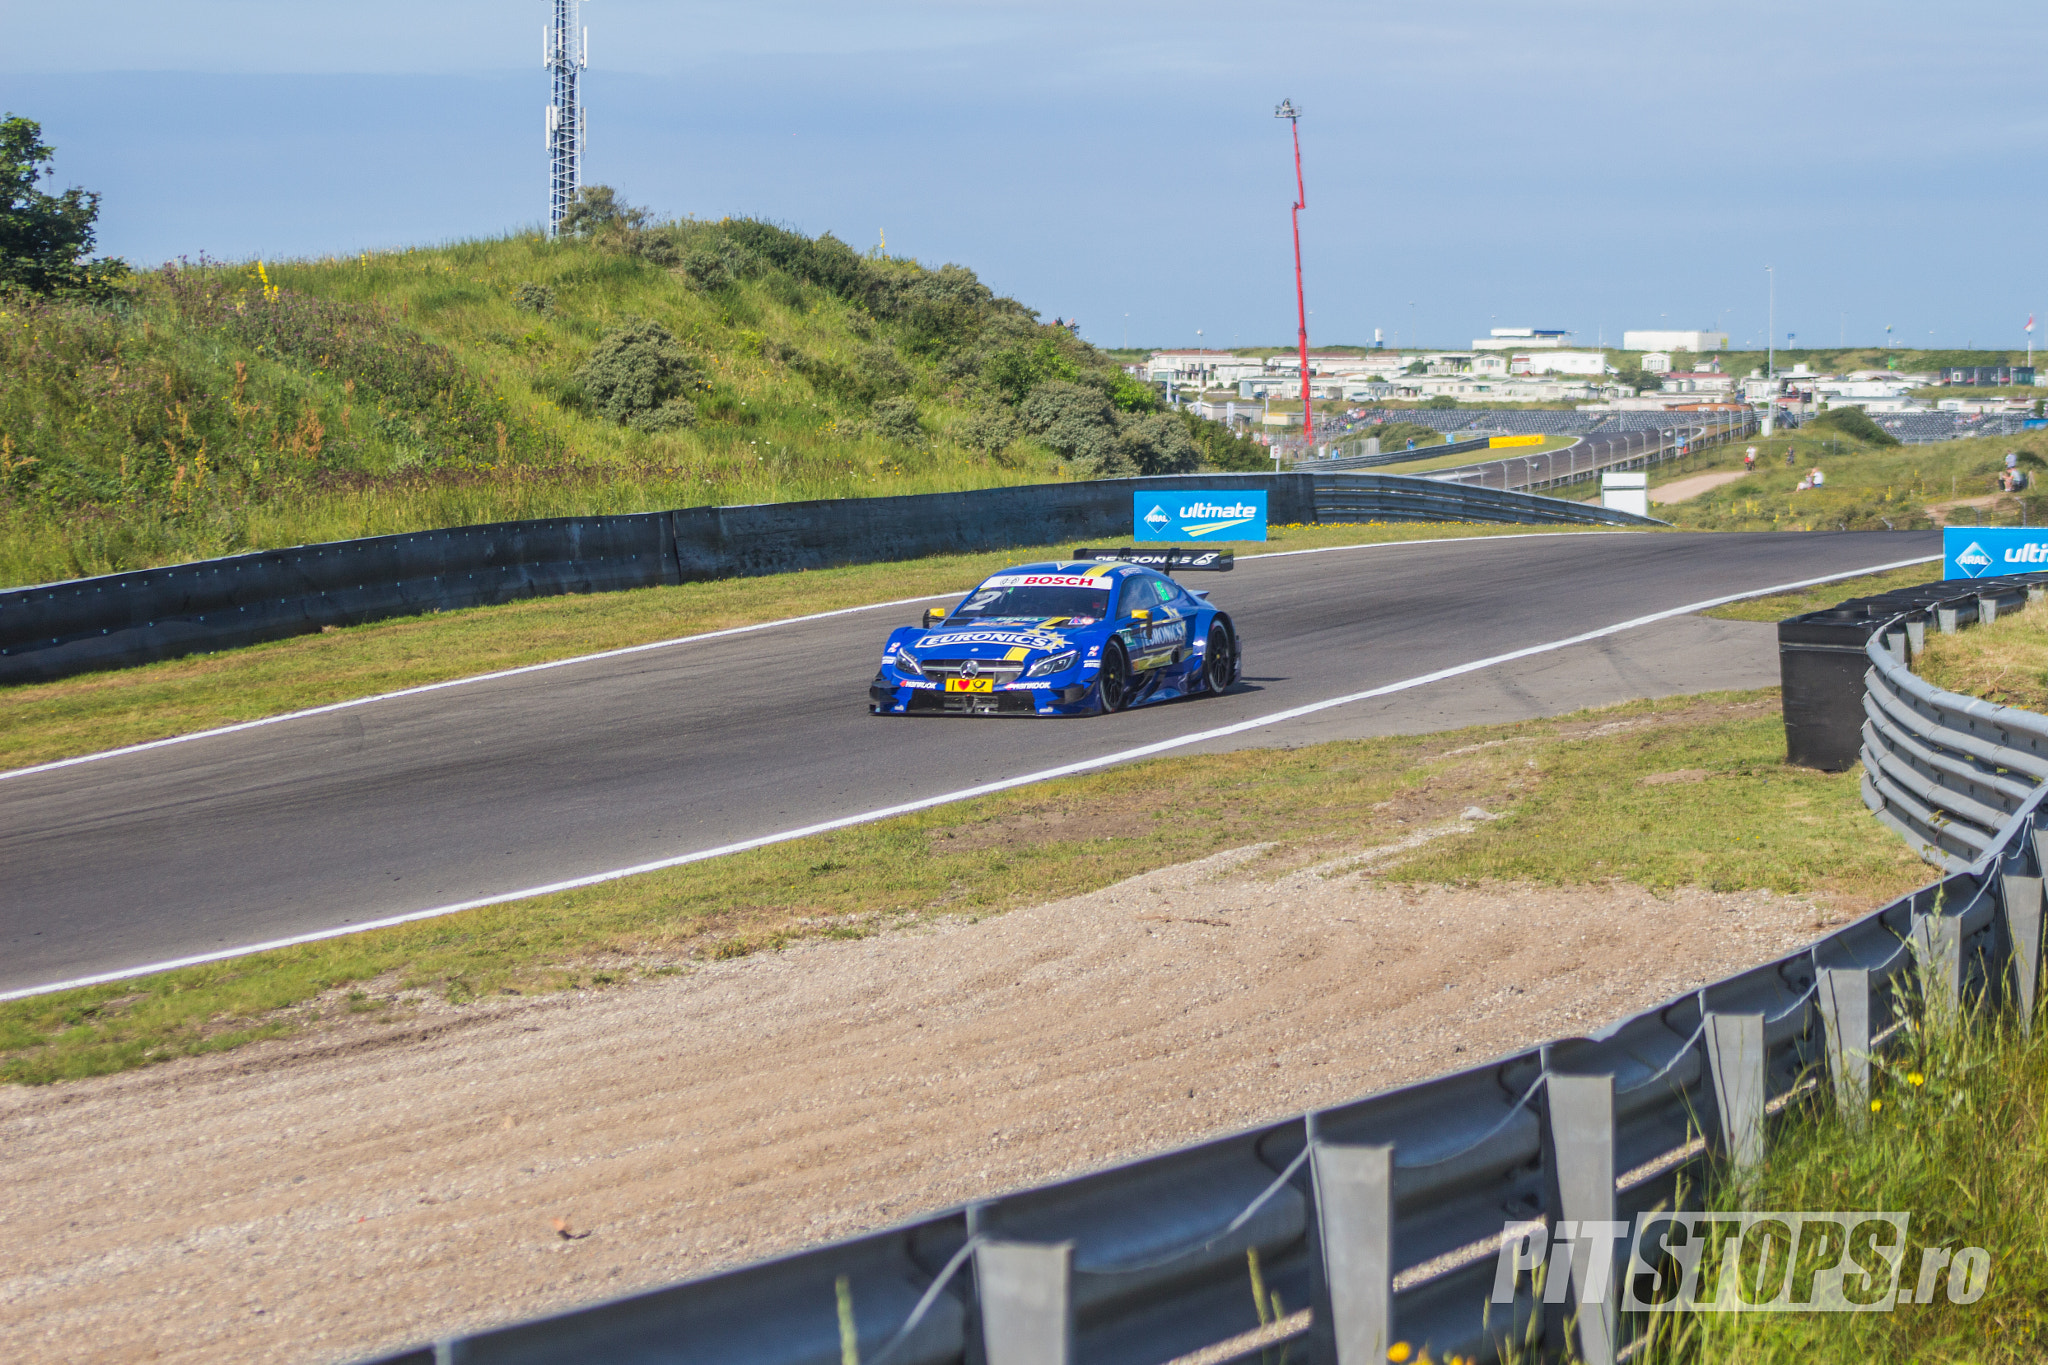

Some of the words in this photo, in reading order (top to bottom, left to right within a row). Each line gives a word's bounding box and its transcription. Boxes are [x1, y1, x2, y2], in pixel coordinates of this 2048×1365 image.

[1179, 502, 1257, 518] ultimate
[1147, 514, 1168, 523] ARAL
[1960, 555, 1988, 565] ARAL
[2004, 543, 2048, 563] ulti
[1024, 576, 1094, 586] BOSCH
[963, 591, 1001, 611] 2
[926, 632, 1048, 647] EURONICS
